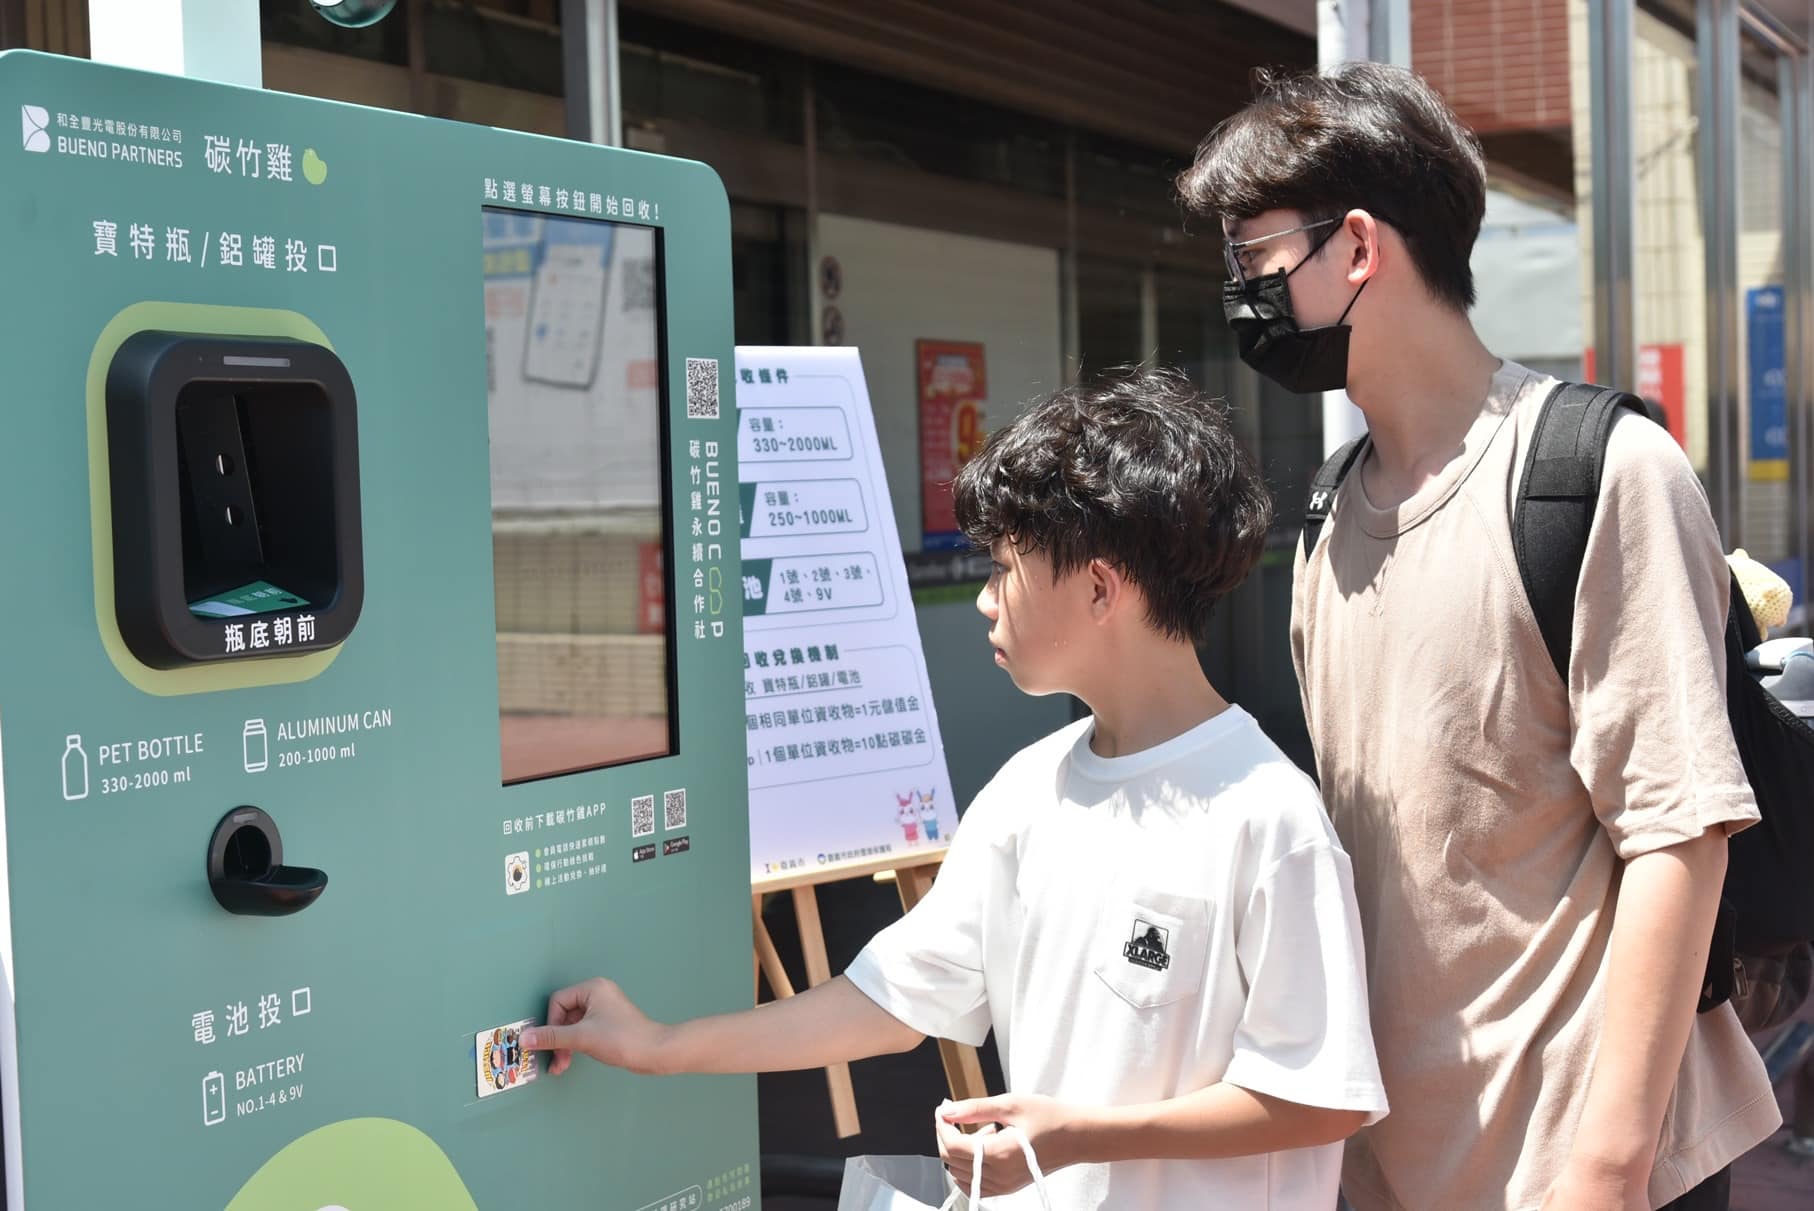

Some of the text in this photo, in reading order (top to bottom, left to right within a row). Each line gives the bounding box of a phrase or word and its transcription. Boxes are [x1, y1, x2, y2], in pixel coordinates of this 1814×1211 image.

[57, 135, 183, 169] BUENO PARTNERS
[204, 134, 293, 182] 碳竹雞
[753, 437, 838, 453] 330~2000ML
[705, 441, 720, 536] BUENO
[768, 508, 853, 527] 250~1000ML
[225, 614, 316, 653] 瓶底朝前
[277, 709, 393, 741] ALUMINUM CAN
[99, 733, 204, 766] PET BOTTLE
[279, 743, 356, 767] 200-1000 ml
[101, 766, 191, 794] 330-2000 ml
[192, 986, 311, 1044] 電池投口
[235, 1053, 305, 1090] BATTERY
[289, 1084, 304, 1101] 9V
